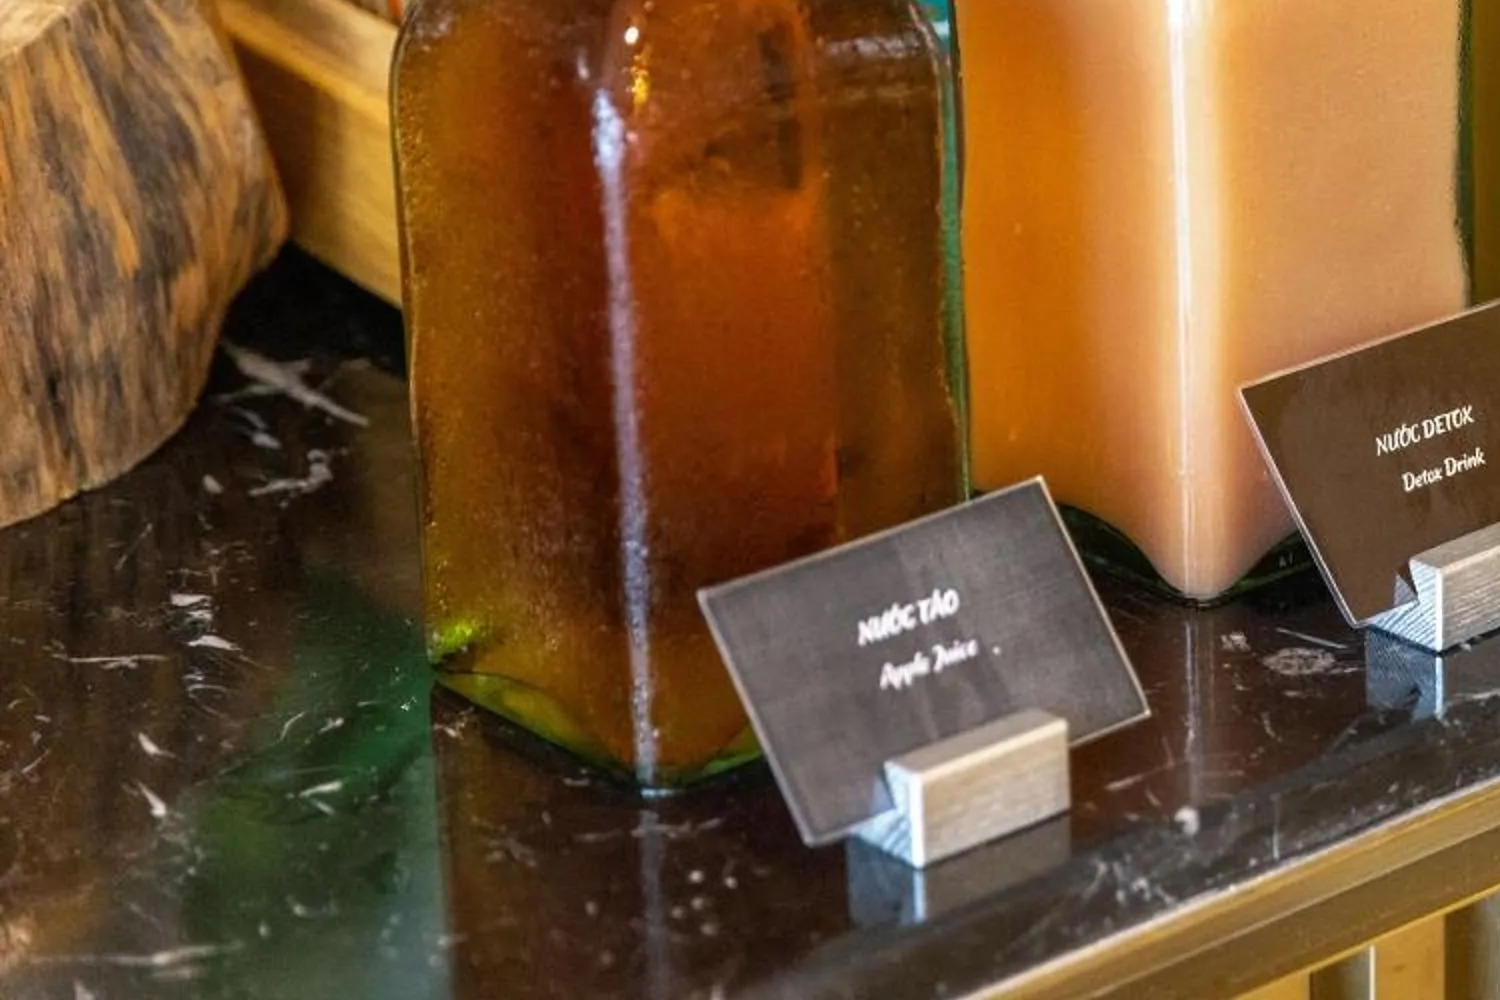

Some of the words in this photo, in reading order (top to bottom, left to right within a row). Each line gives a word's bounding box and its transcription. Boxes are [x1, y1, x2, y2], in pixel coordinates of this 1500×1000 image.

[1421, 404, 1475, 439] DETOX
[1402, 471, 1443, 493] Detox
[1443, 447, 1486, 477] Drink
[931, 638, 978, 673] Juice
